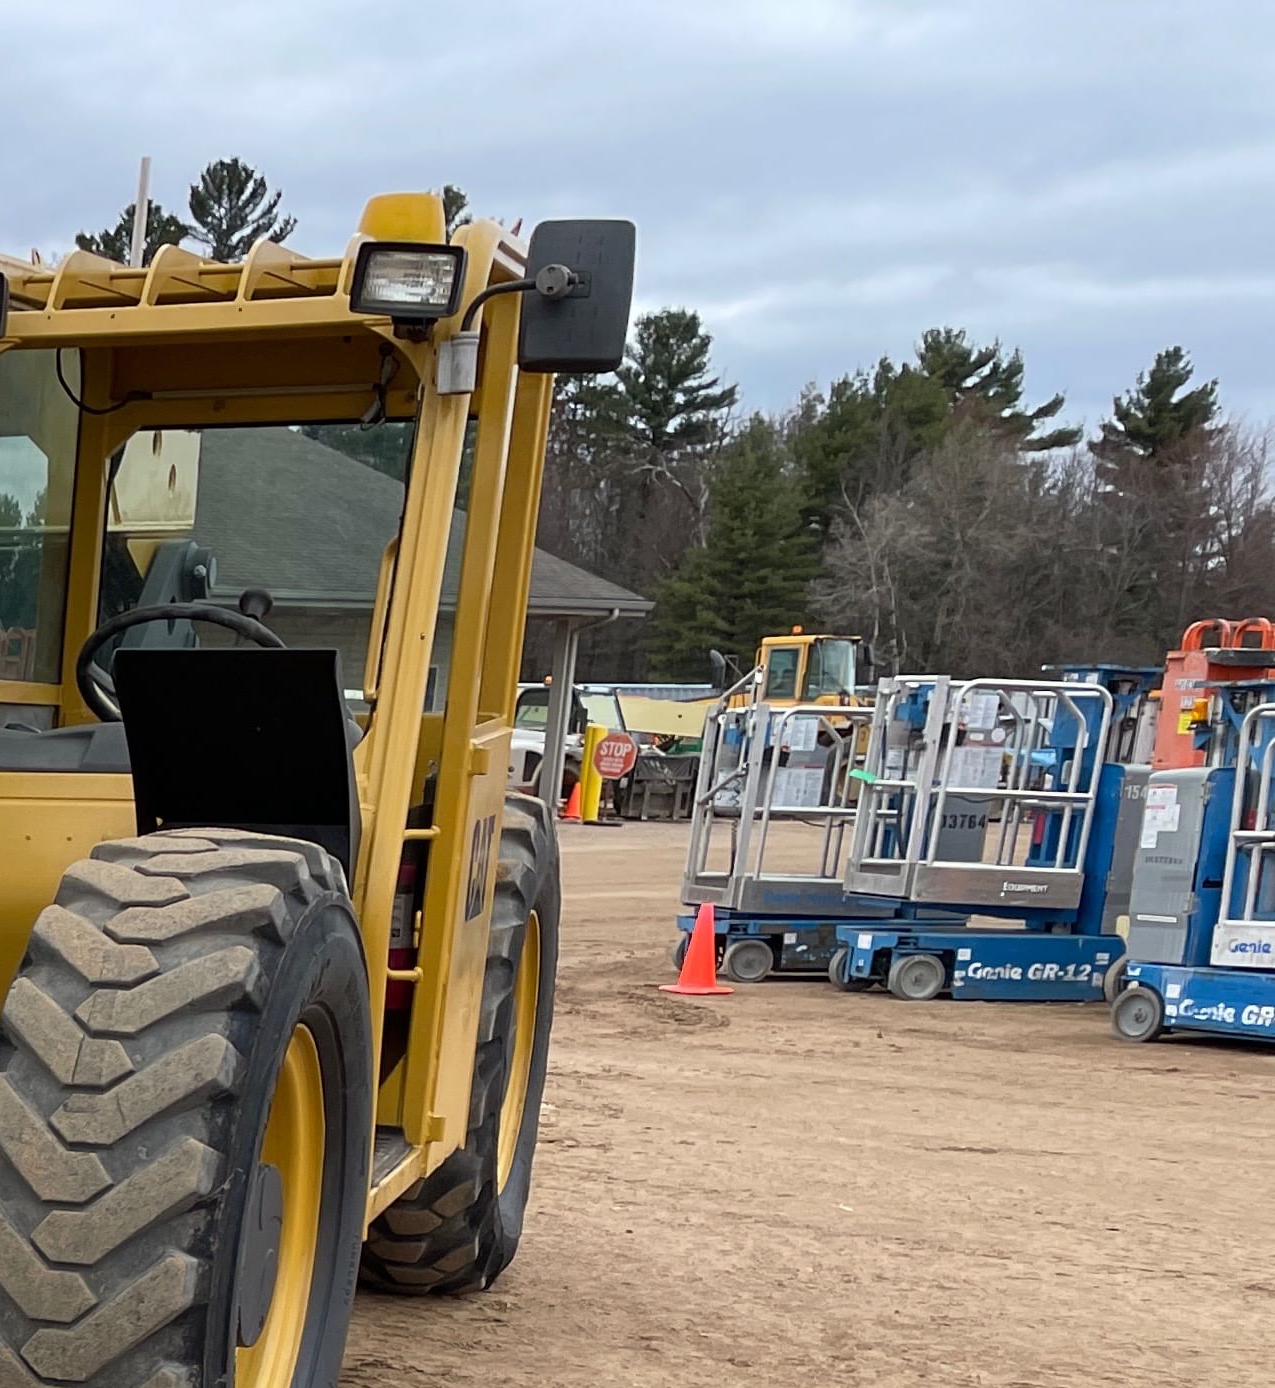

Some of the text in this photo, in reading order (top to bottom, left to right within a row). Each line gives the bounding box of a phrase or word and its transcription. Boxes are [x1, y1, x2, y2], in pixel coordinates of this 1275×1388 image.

[600, 741, 632, 758] STOP
[464, 814, 496, 922] CAT
[1228, 938, 1272, 954] Genie
[967, 962, 1092, 982] Genie GR-12
